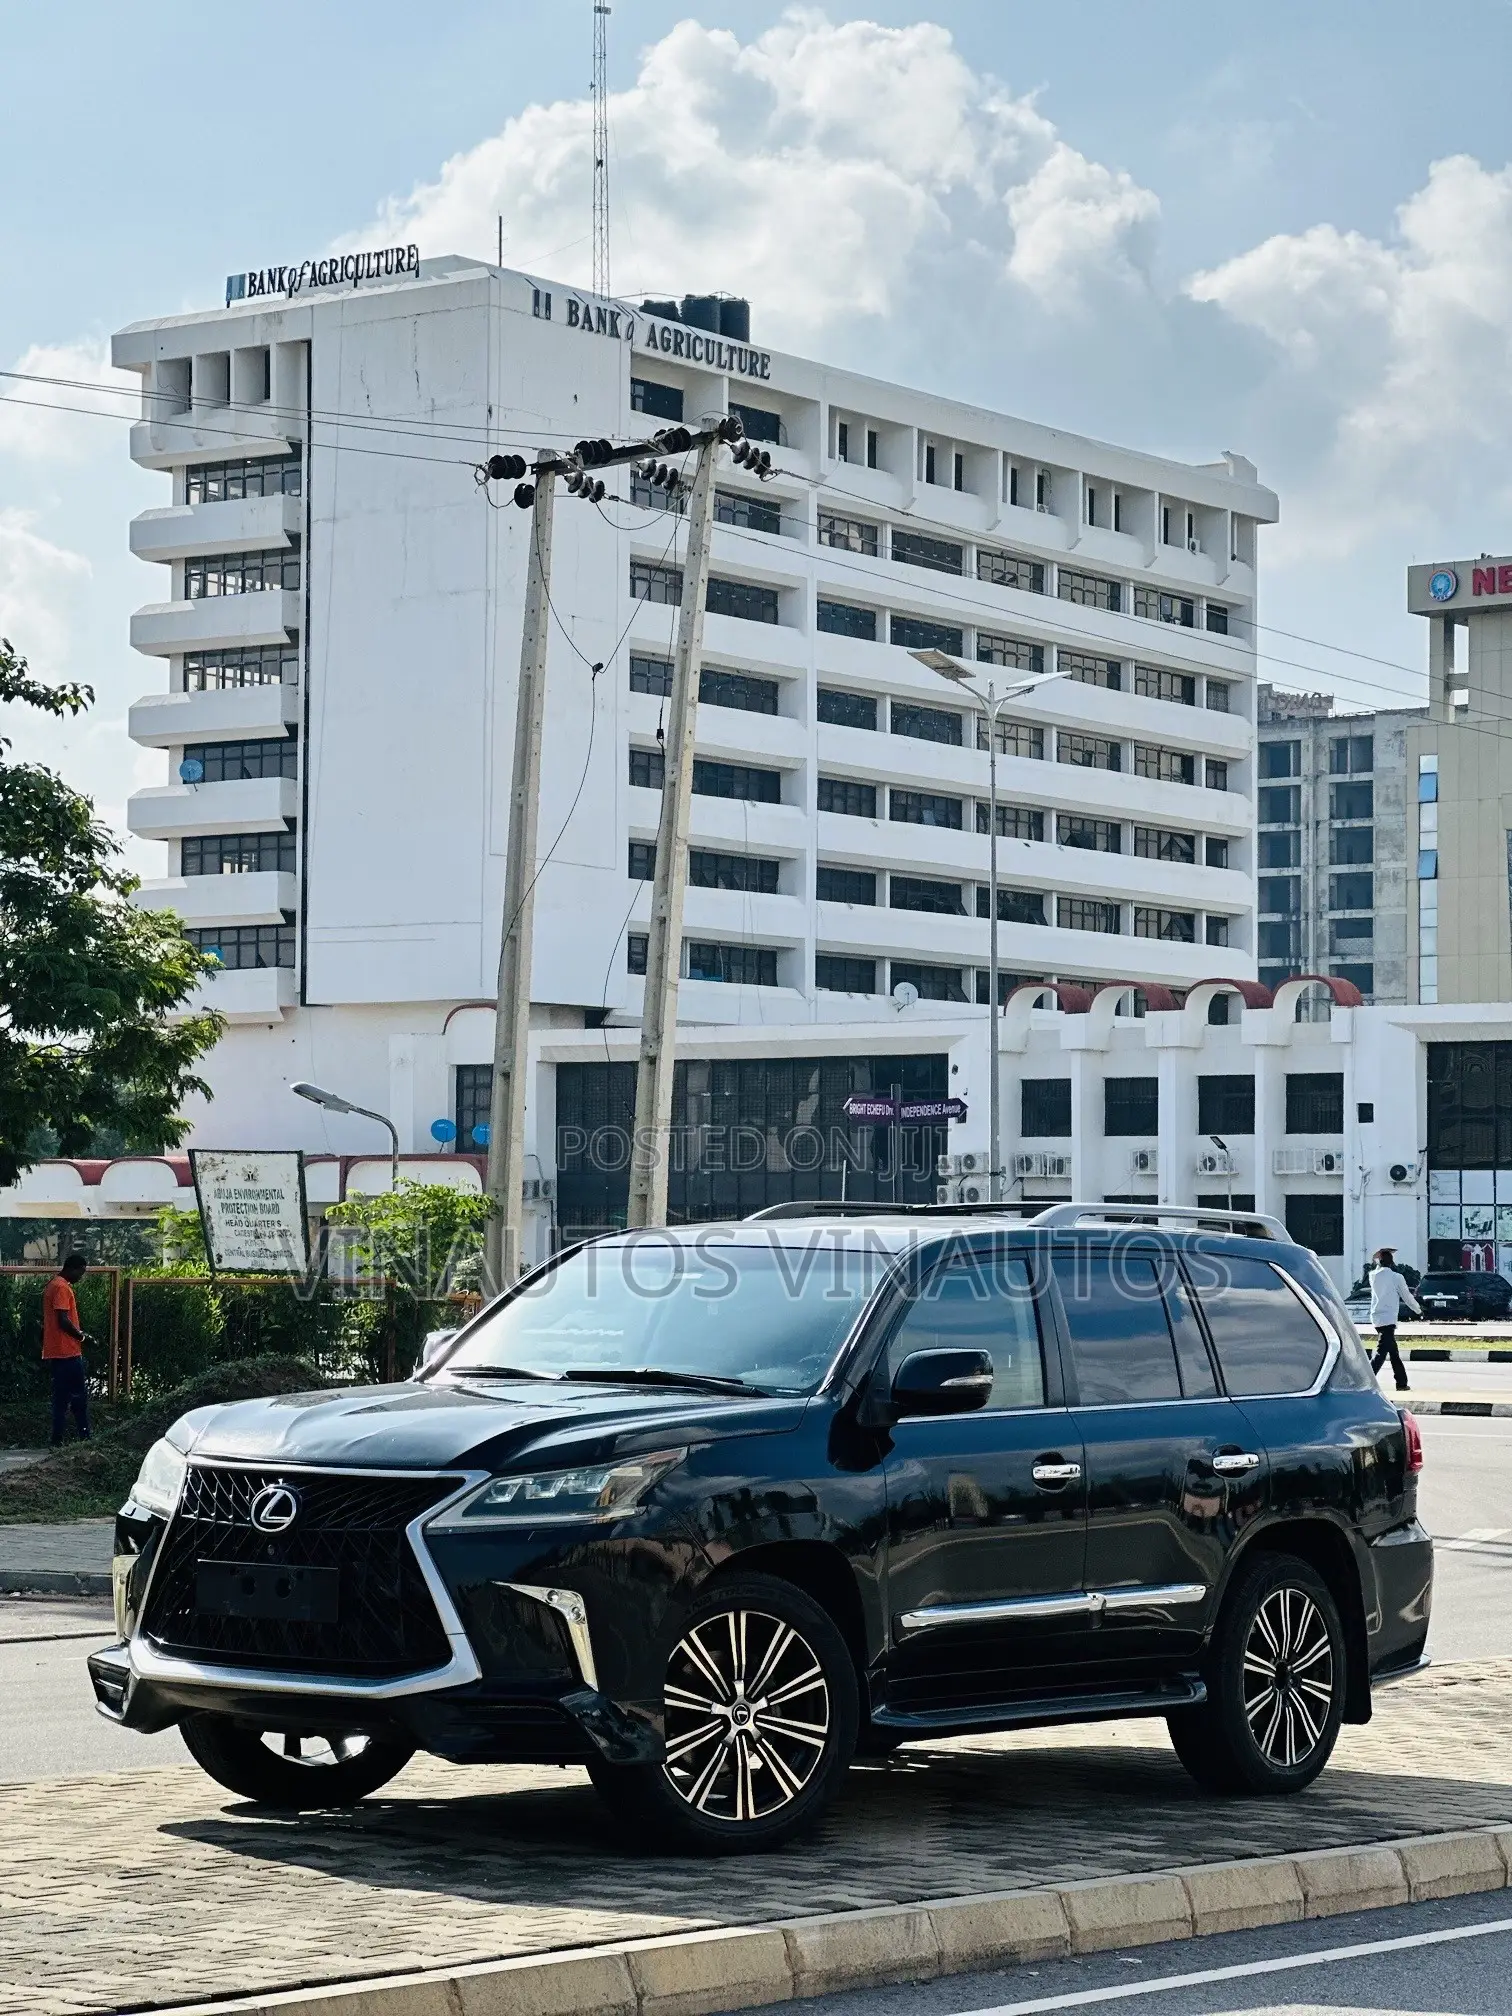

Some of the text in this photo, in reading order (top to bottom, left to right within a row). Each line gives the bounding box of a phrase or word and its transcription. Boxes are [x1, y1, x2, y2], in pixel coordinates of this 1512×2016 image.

[247, 244, 417, 297] BANK of AGRICULTURE
[567, 298, 621, 339] BANK
[645, 322, 771, 380] AGRICULTURE
[900, 1103, 961, 1118] INDEPENDENCE Avenue
[260, 1202, 280, 1215] BOARD
[225, 1219, 244, 1228] HEAD
